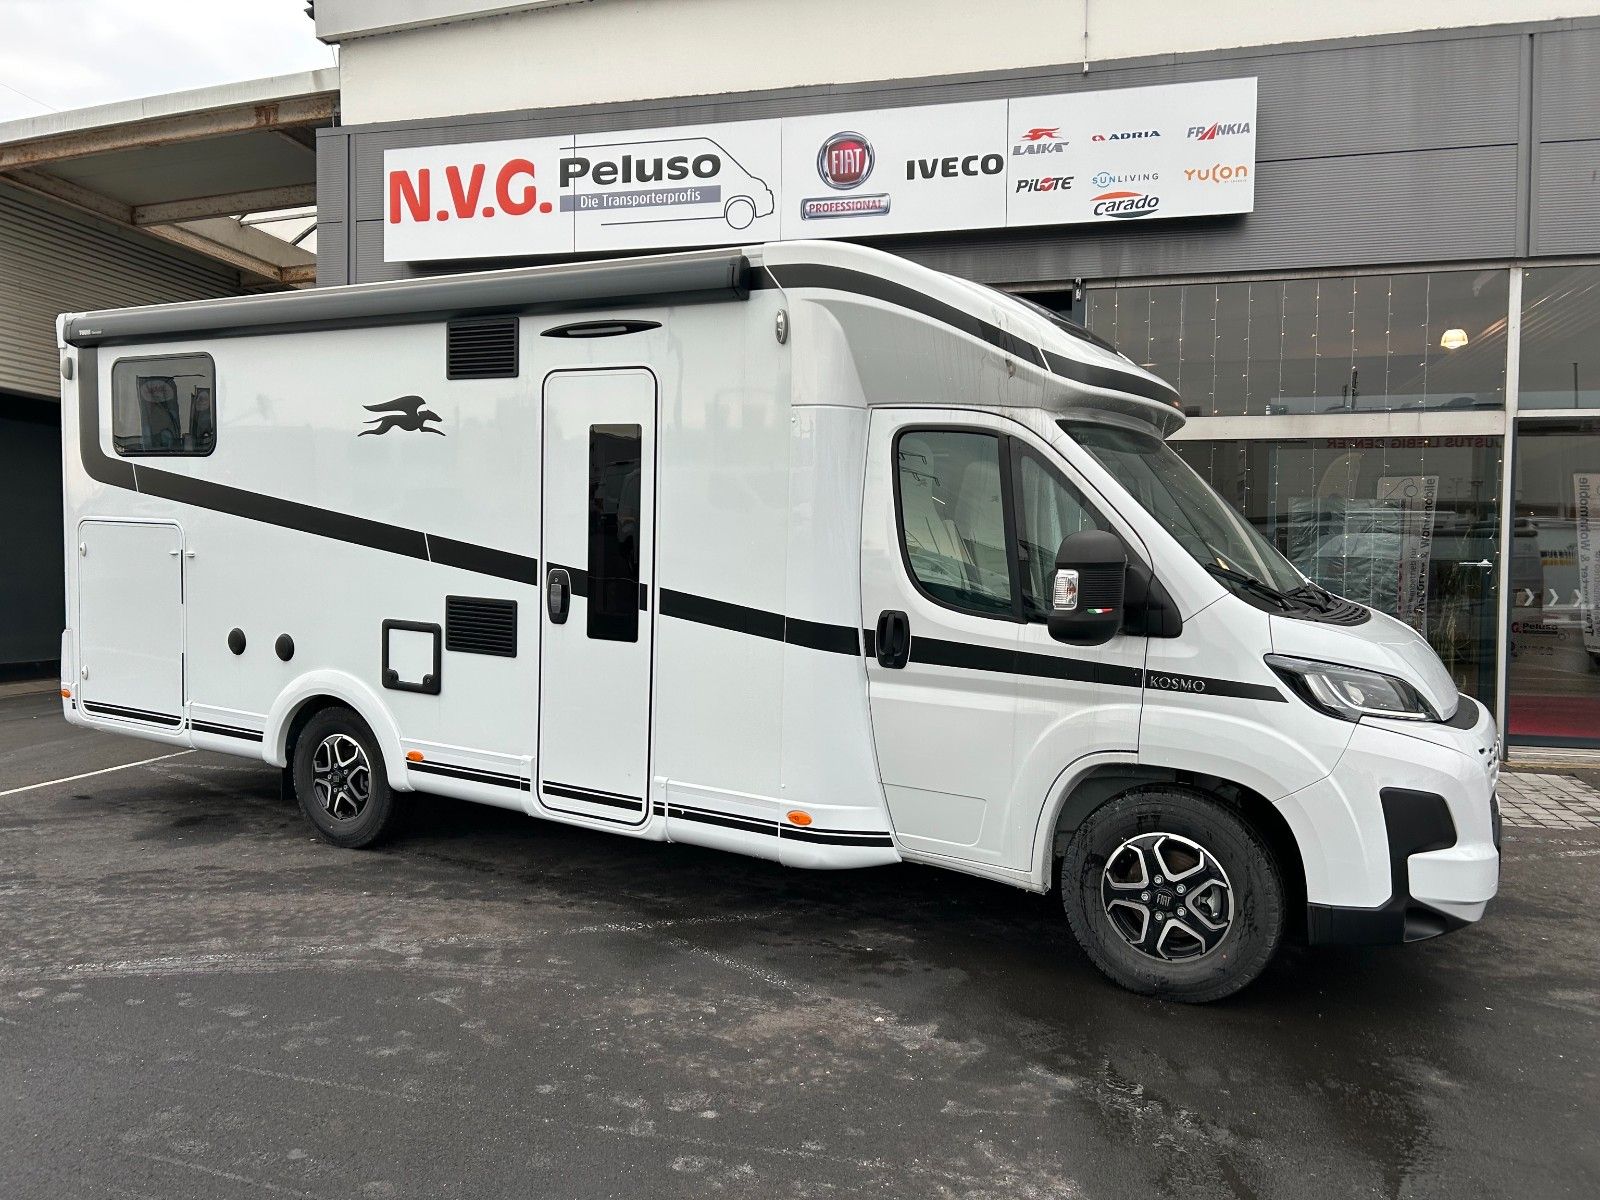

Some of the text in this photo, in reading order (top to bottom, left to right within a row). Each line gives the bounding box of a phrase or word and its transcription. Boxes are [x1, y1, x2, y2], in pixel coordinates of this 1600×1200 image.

[1108, 130, 1161, 141] ADRIA
[1186, 122, 1251, 141] FRANKIA
[1012, 141, 1070, 156] LAIKA
[559, 153, 722, 188] Peluso
[831, 148, 863, 175] FIAT
[906, 153, 1005, 181] IVECO
[1092, 172, 1159, 186] SUNLIVING
[389, 158, 553, 225] N.V.G.
[580, 188, 701, 208] Die Transporterprofis
[808, 199, 884, 214] PROFESSIONAL
[1522, 622, 1559, 631] Peluso
[1149, 675, 1206, 693] KOSMO
[1156, 893, 1172, 907] FIAT
